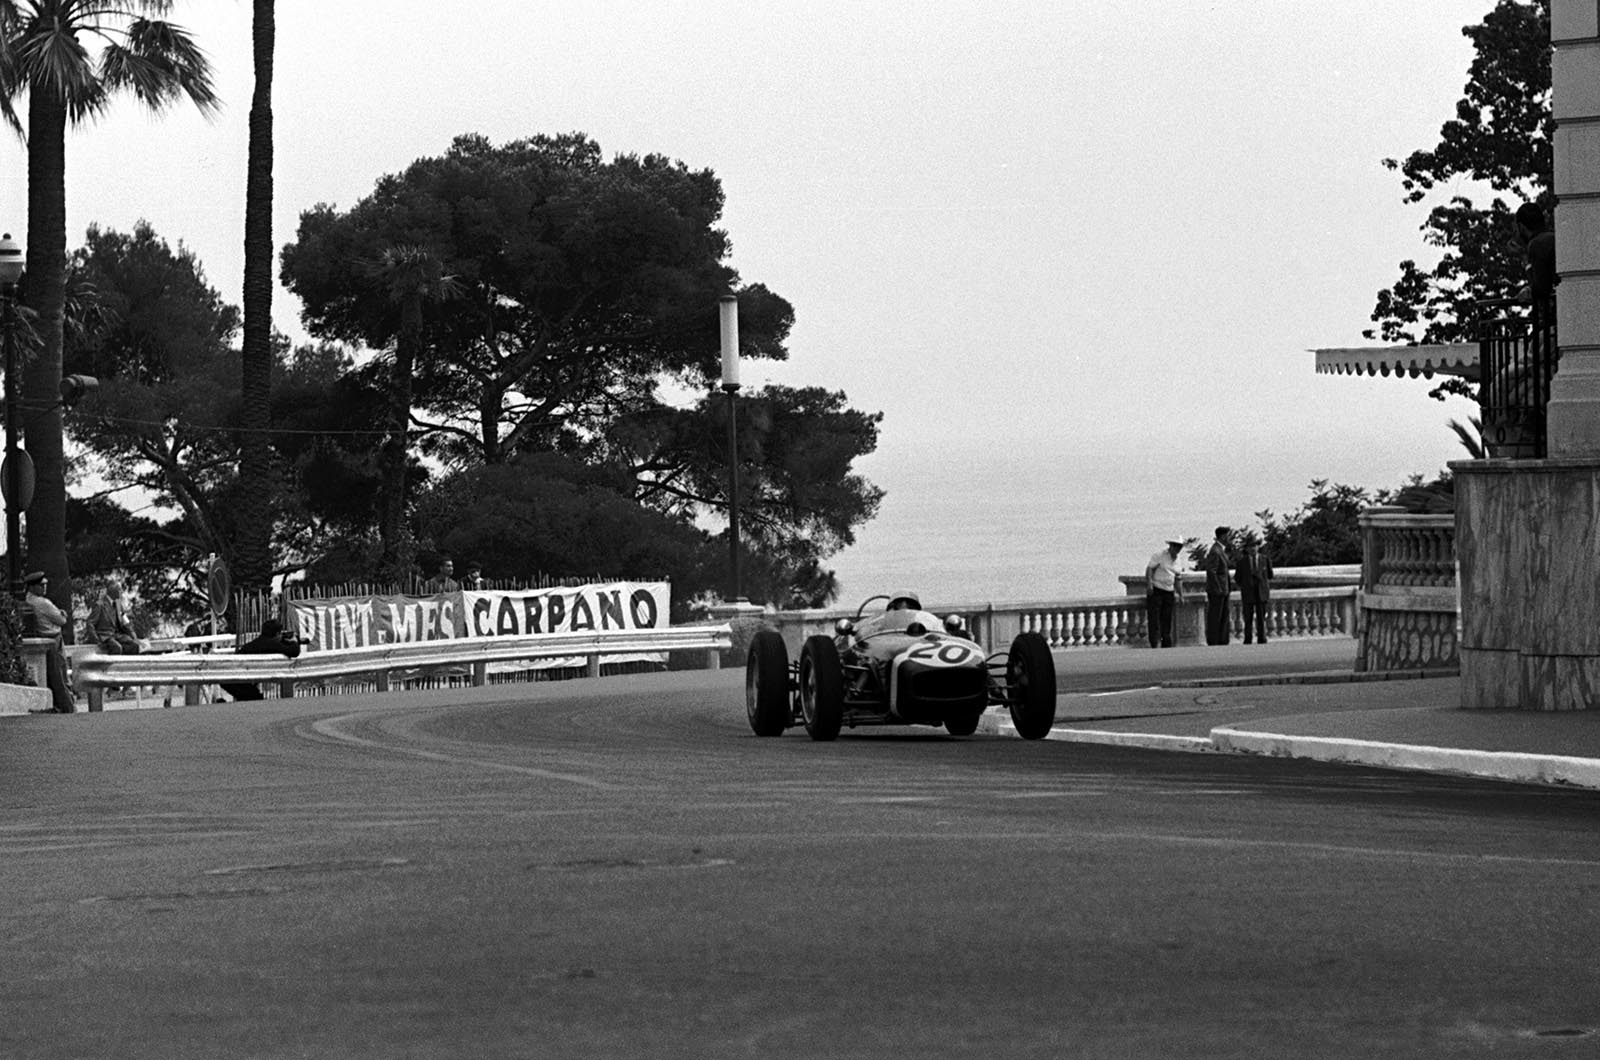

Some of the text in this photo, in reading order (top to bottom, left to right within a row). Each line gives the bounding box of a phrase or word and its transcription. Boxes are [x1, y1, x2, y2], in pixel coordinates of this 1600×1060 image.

[388, 601, 455, 643] MES
[473, 589, 657, 636] CARPANO
[908, 641, 971, 664] 20
